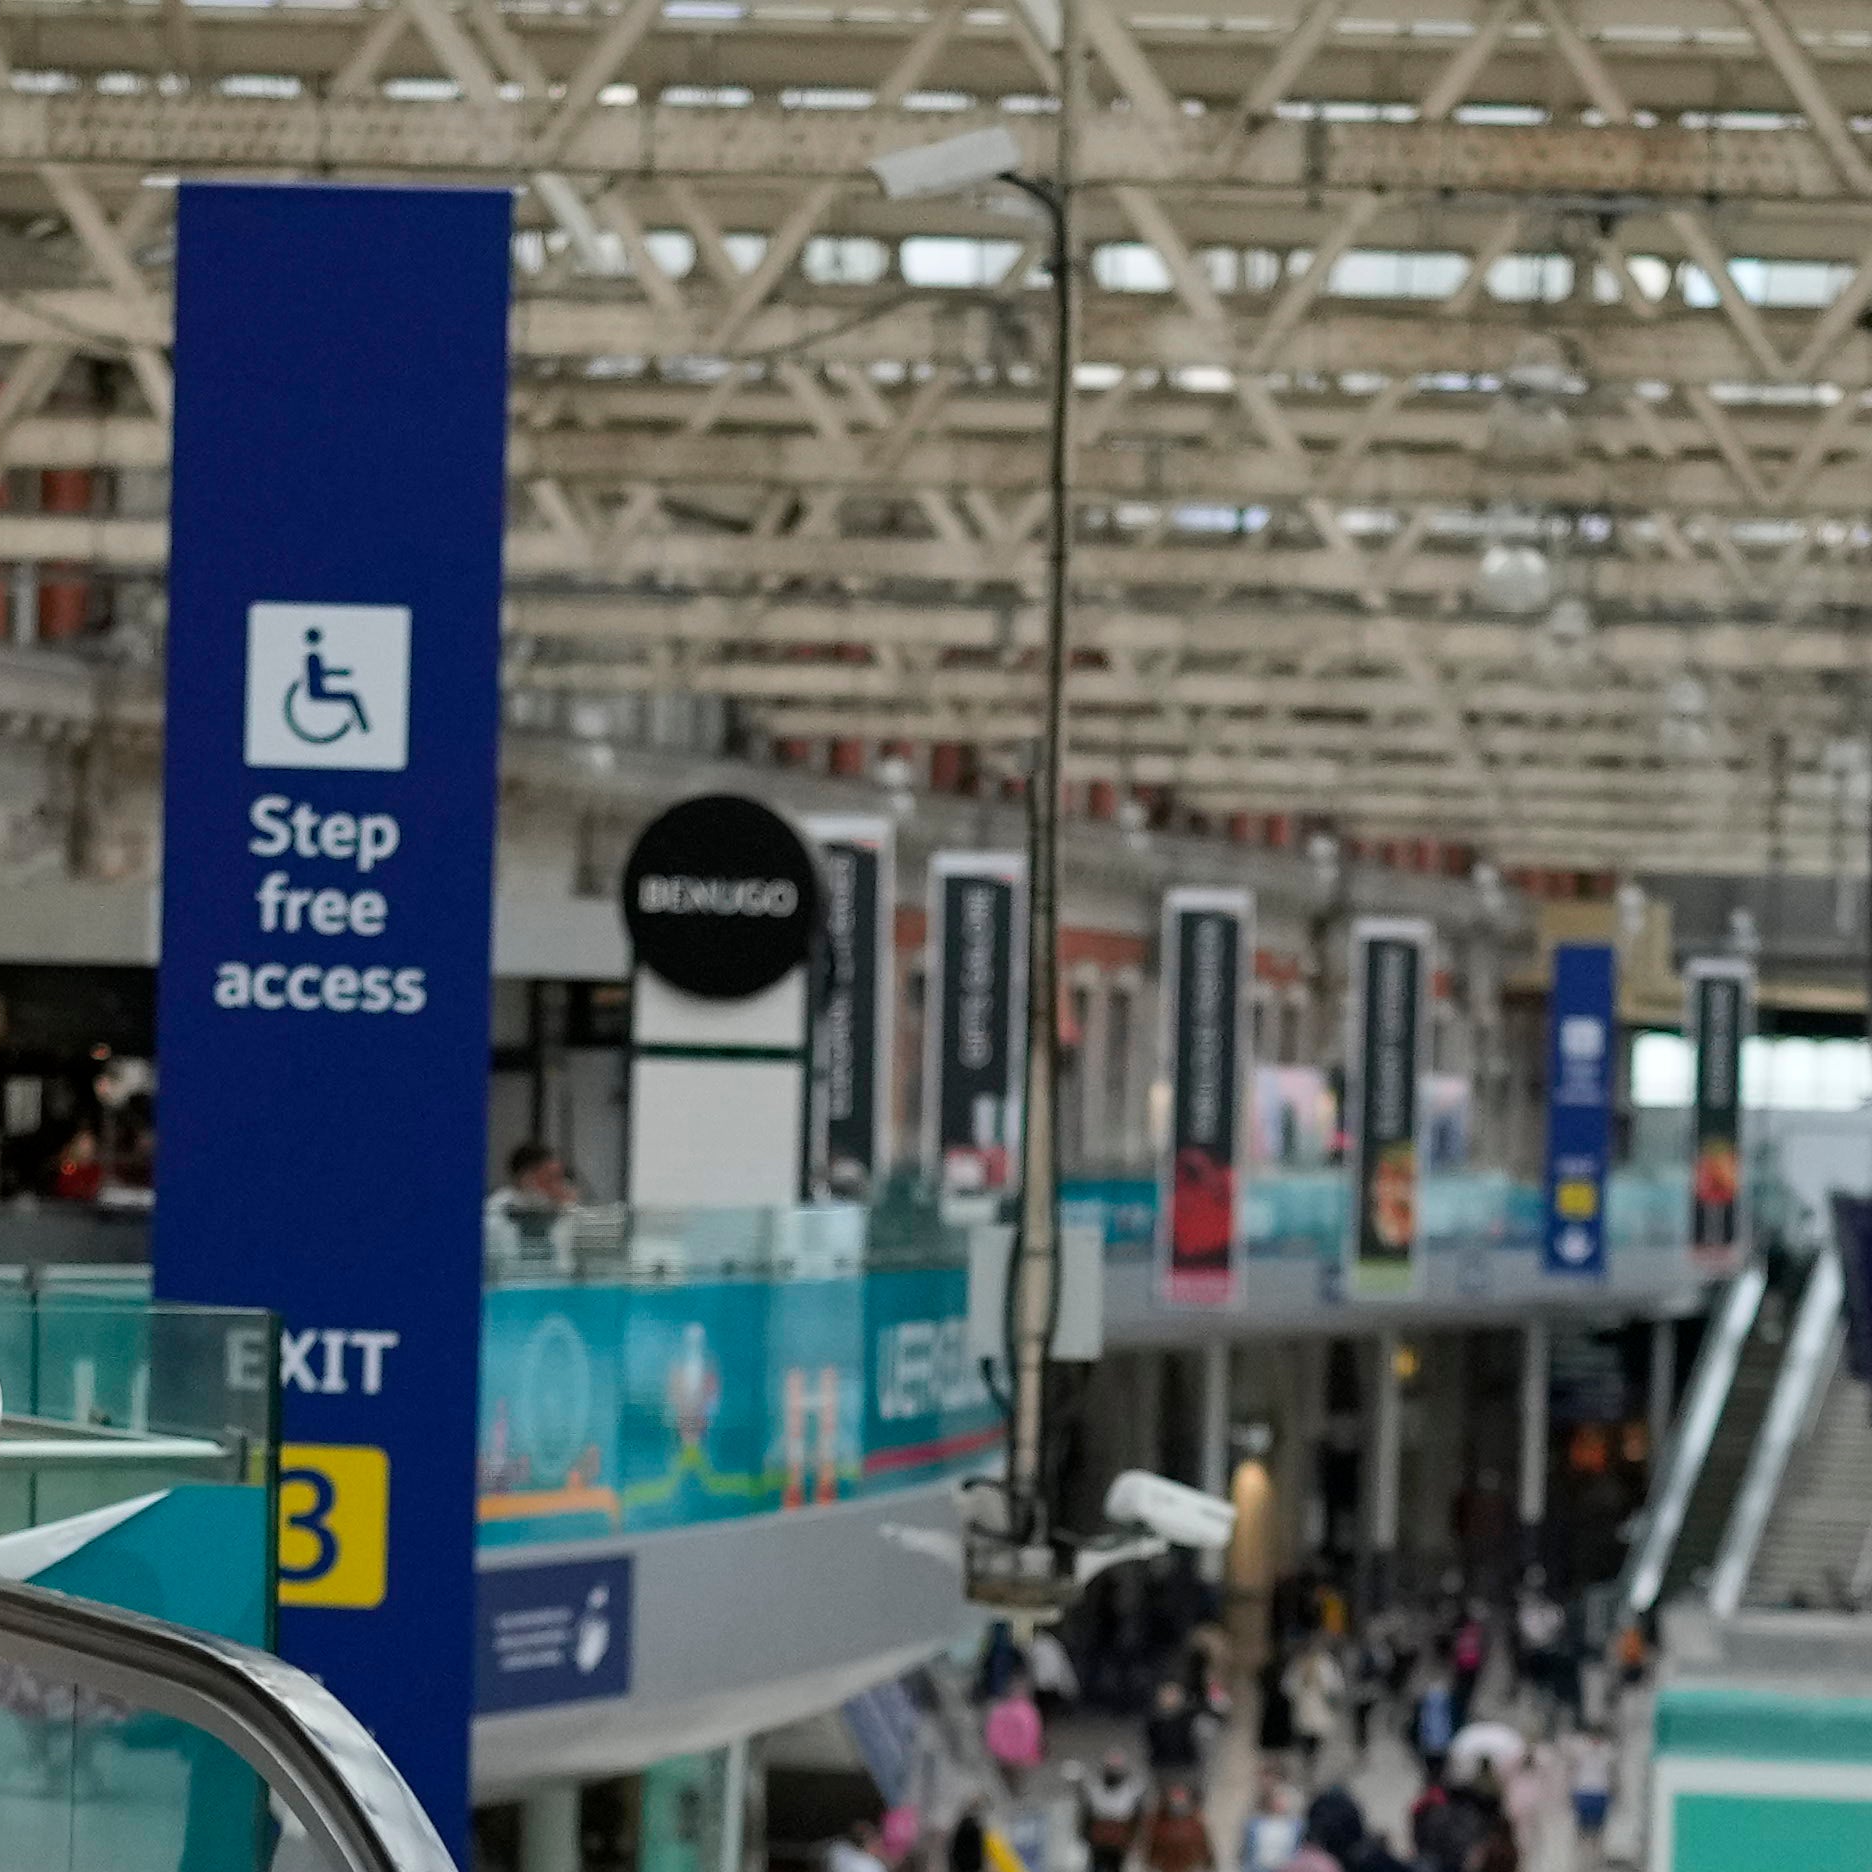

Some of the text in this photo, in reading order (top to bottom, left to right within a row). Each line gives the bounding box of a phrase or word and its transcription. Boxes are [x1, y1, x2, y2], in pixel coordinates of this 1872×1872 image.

[249, 794, 400, 873] Step
[256, 870, 388, 936] free
[638, 873, 800, 918] BENUGO
[213, 961, 428, 1014] access
[227, 1327, 400, 1396] EXIT
[278, 1466, 341, 1582] 3
